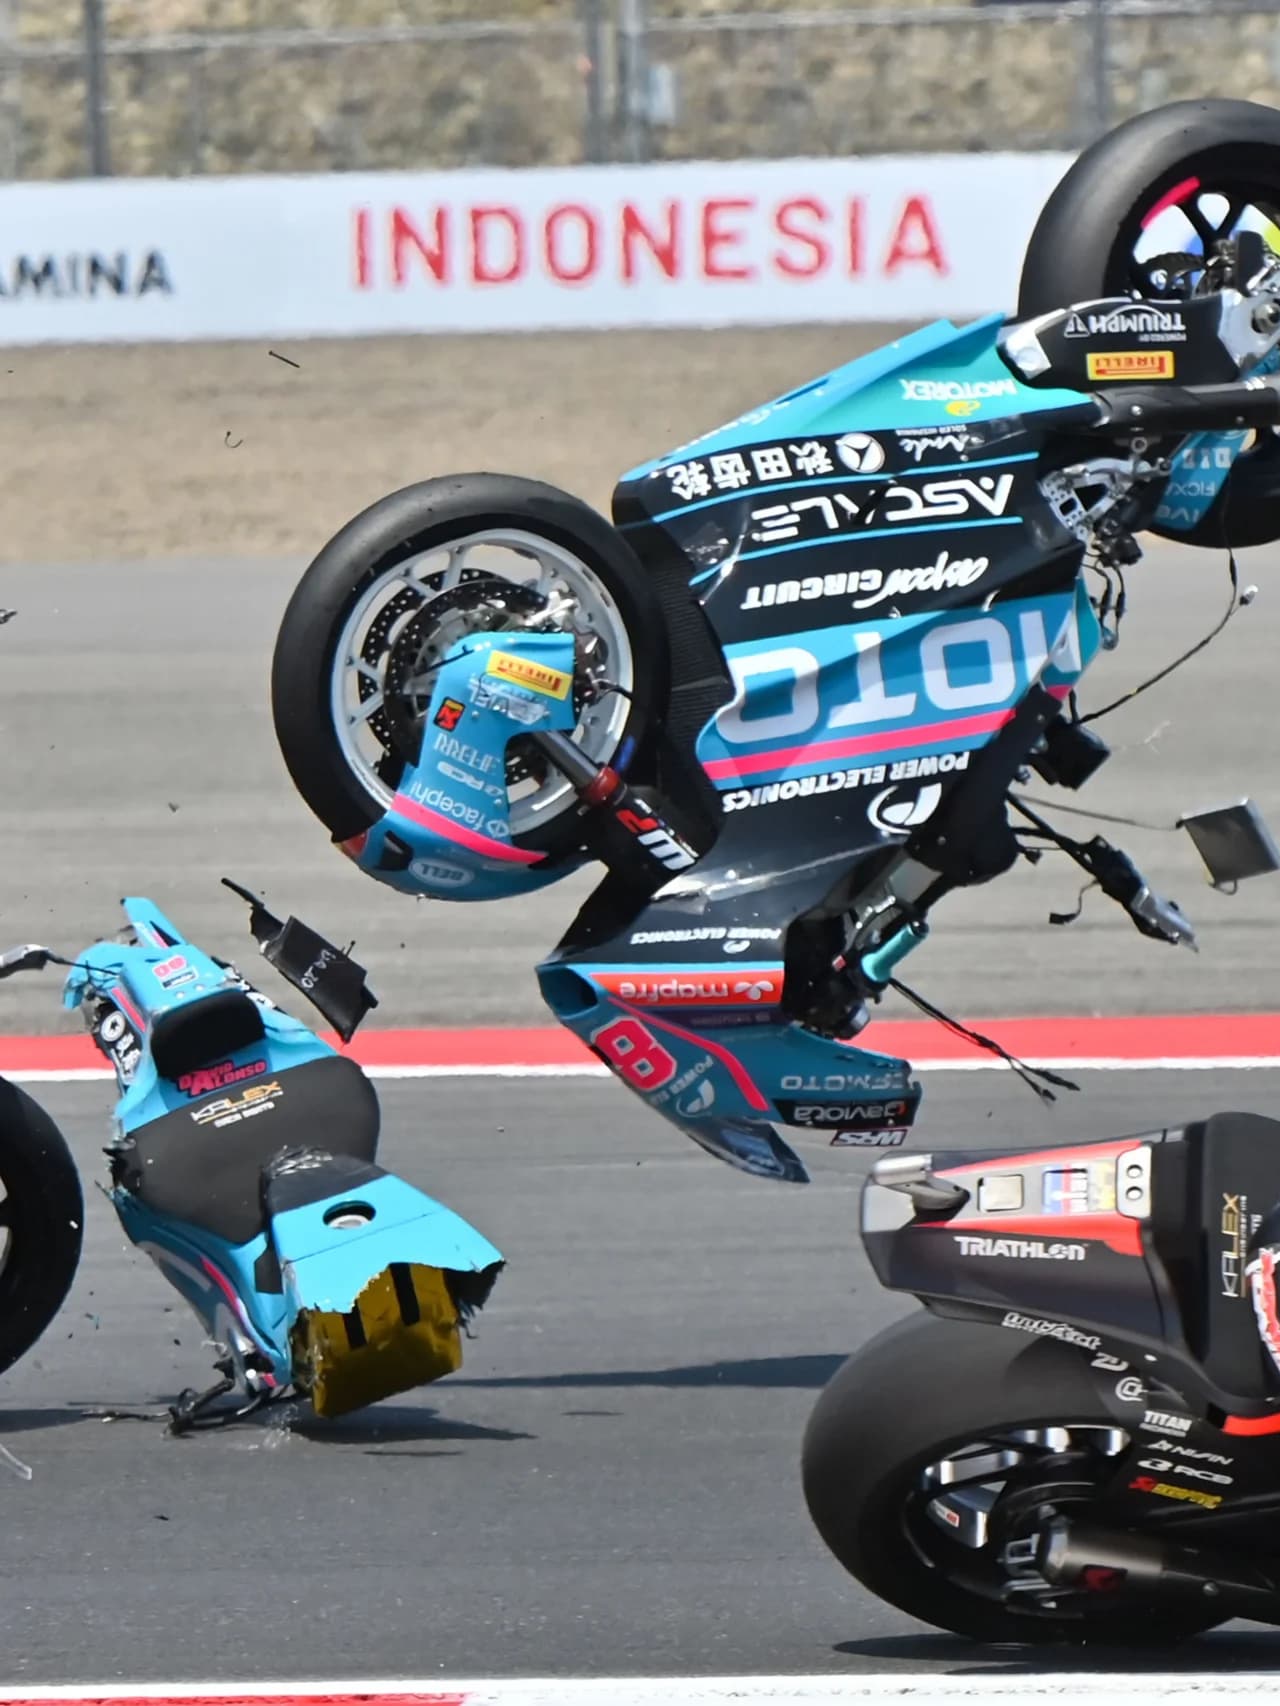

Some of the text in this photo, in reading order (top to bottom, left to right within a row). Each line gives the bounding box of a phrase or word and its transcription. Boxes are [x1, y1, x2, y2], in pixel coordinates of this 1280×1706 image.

[354, 196, 946, 290] INDONESIA
[1088, 308, 1187, 334] TRIUMPH
[1093, 355, 1167, 376] PIRELLI
[900, 378, 1017, 400] MOTOREX
[740, 566, 884, 611] CIRCUIT
[723, 751, 971, 814] POWER ELECTRONICS
[421, 864, 467, 883] BELL
[727, 925, 782, 940] POWER
[618, 978, 729, 1001] mapfre
[837, 1129, 905, 1146] WRS
[1144, 1410, 1193, 1432] TITAN
